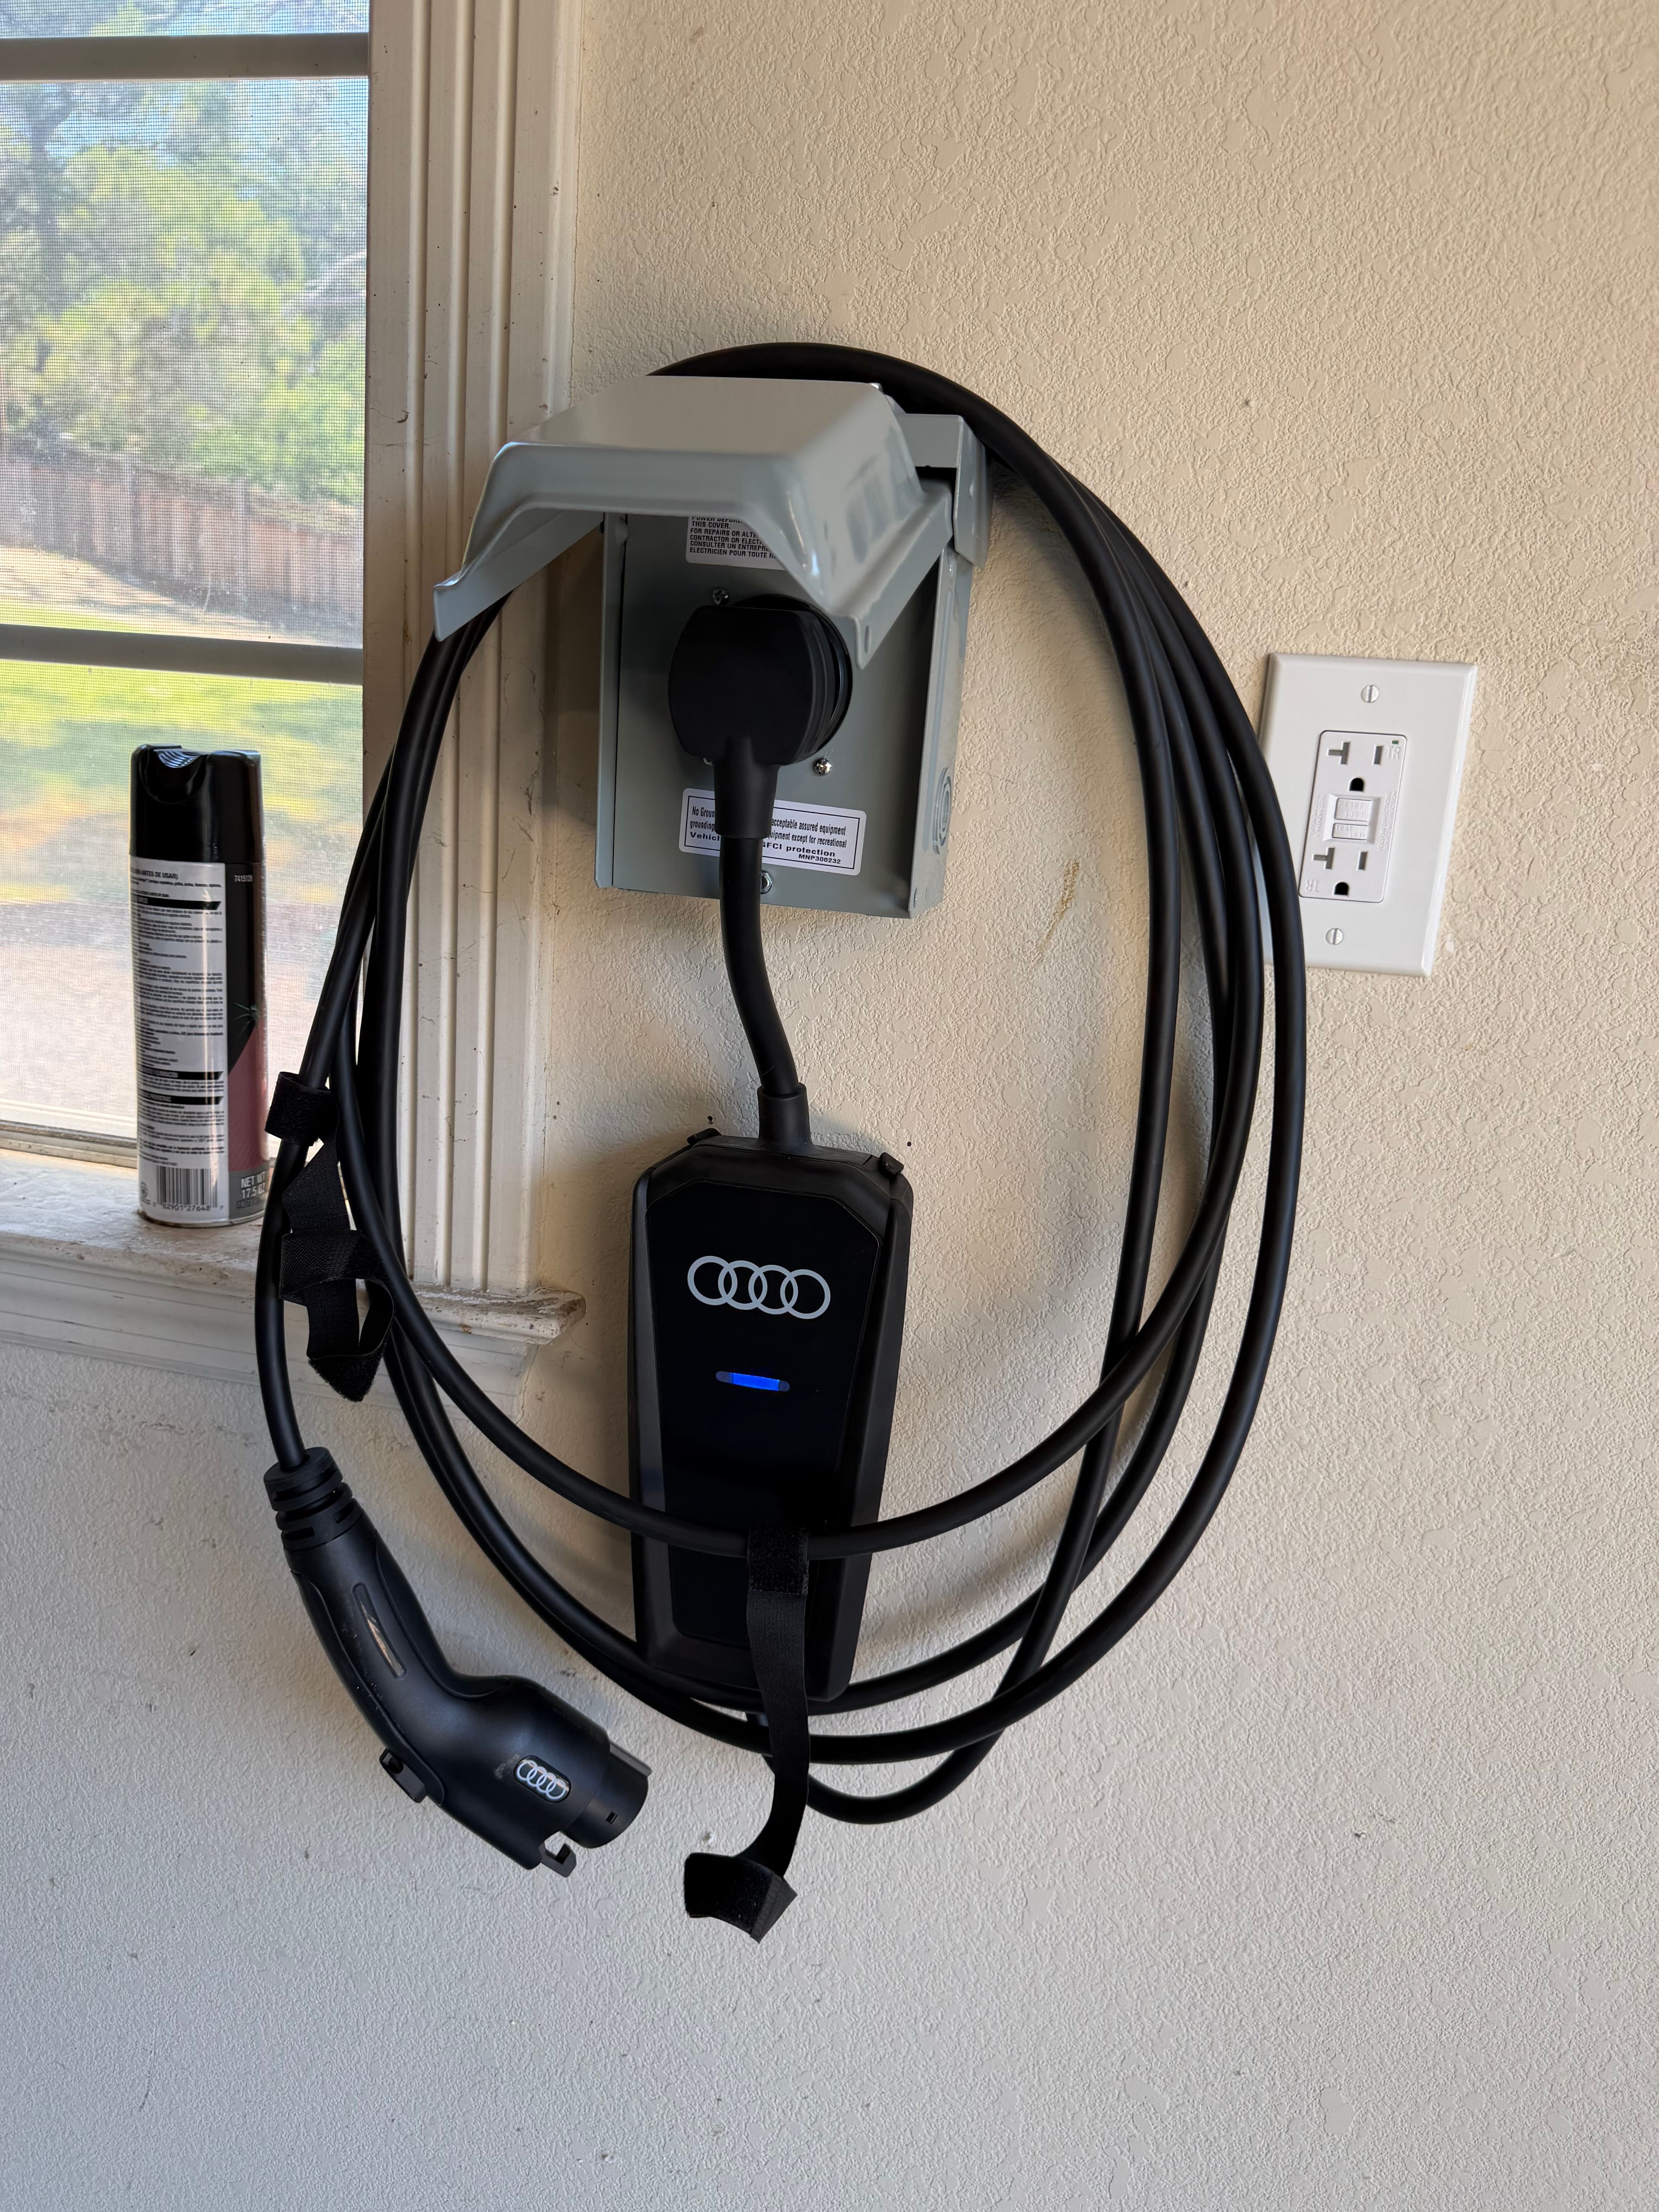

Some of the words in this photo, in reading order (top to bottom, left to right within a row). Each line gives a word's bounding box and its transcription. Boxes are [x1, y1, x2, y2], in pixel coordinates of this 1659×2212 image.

[690, 547, 727, 555] ELECTRICIEN
[1386, 746, 1400, 760] TR
[692, 806, 699, 816] No
[700, 807, 715, 818] Groun
[799, 822, 818, 832] assured
[819, 824, 846, 836] equipment
[690, 821, 715, 832] grounding
[769, 830, 790, 840] uipment
[791, 834, 808, 844] except
[817, 838, 847, 848] recreational
[690, 832, 720, 841] Vehicl
[786, 846, 835, 857] protection
[798, 854, 841, 864] MNP300232
[241, 1176, 256, 1188] NET
[257, 1171, 266, 1184] WT
[242, 1186, 257, 1199] 17.5
[258, 1182, 265, 1195] OZ
